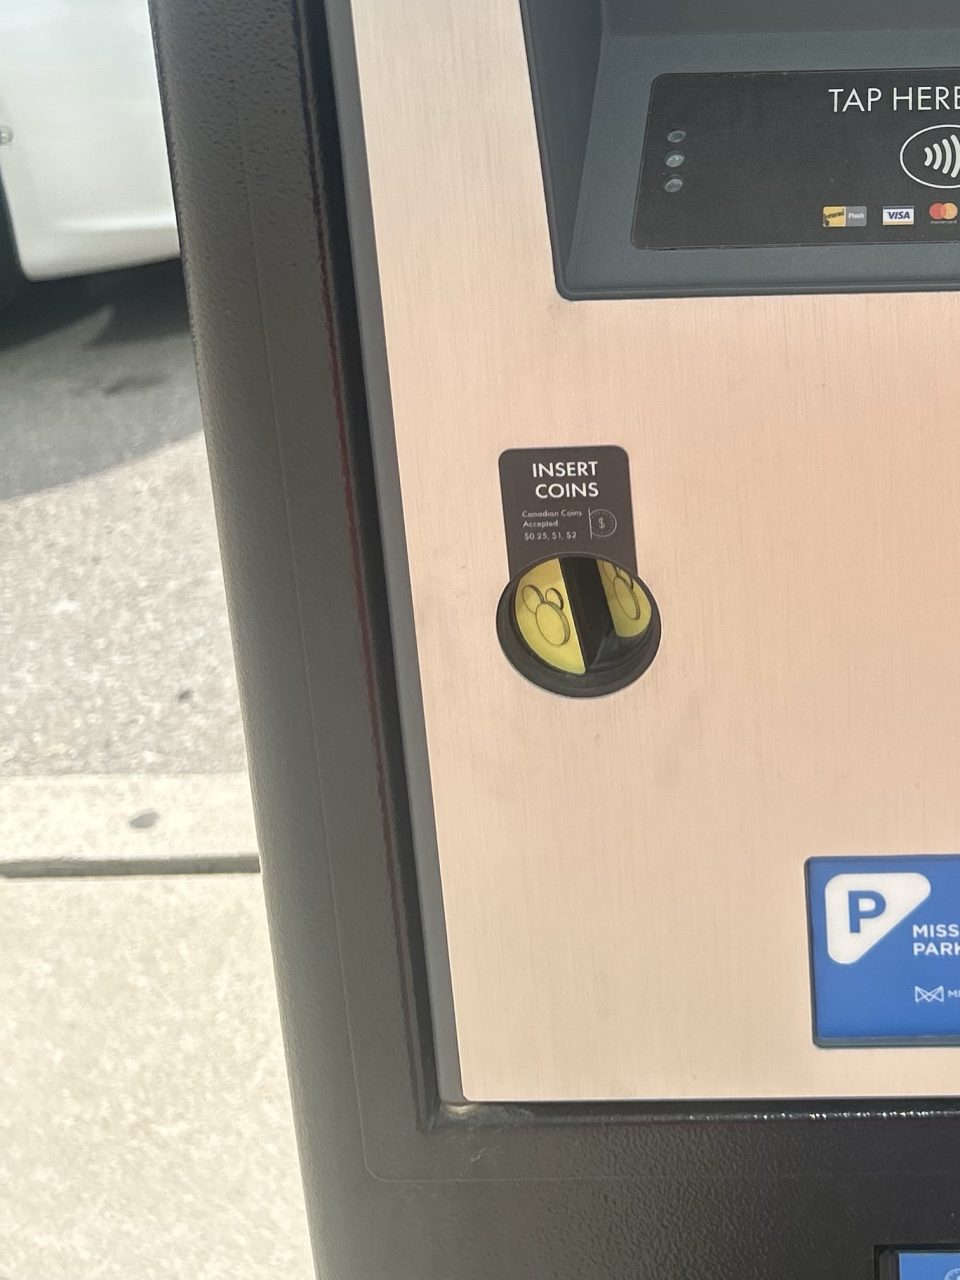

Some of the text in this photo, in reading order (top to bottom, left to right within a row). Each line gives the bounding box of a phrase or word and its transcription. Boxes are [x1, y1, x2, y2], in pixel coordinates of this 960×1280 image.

[828, 88, 882, 113] TAP
[888, 211, 910, 219] VISA
[532, 461, 598, 478] INSERT
[535, 483, 599, 499] COINS
[848, 890, 886, 933] P
